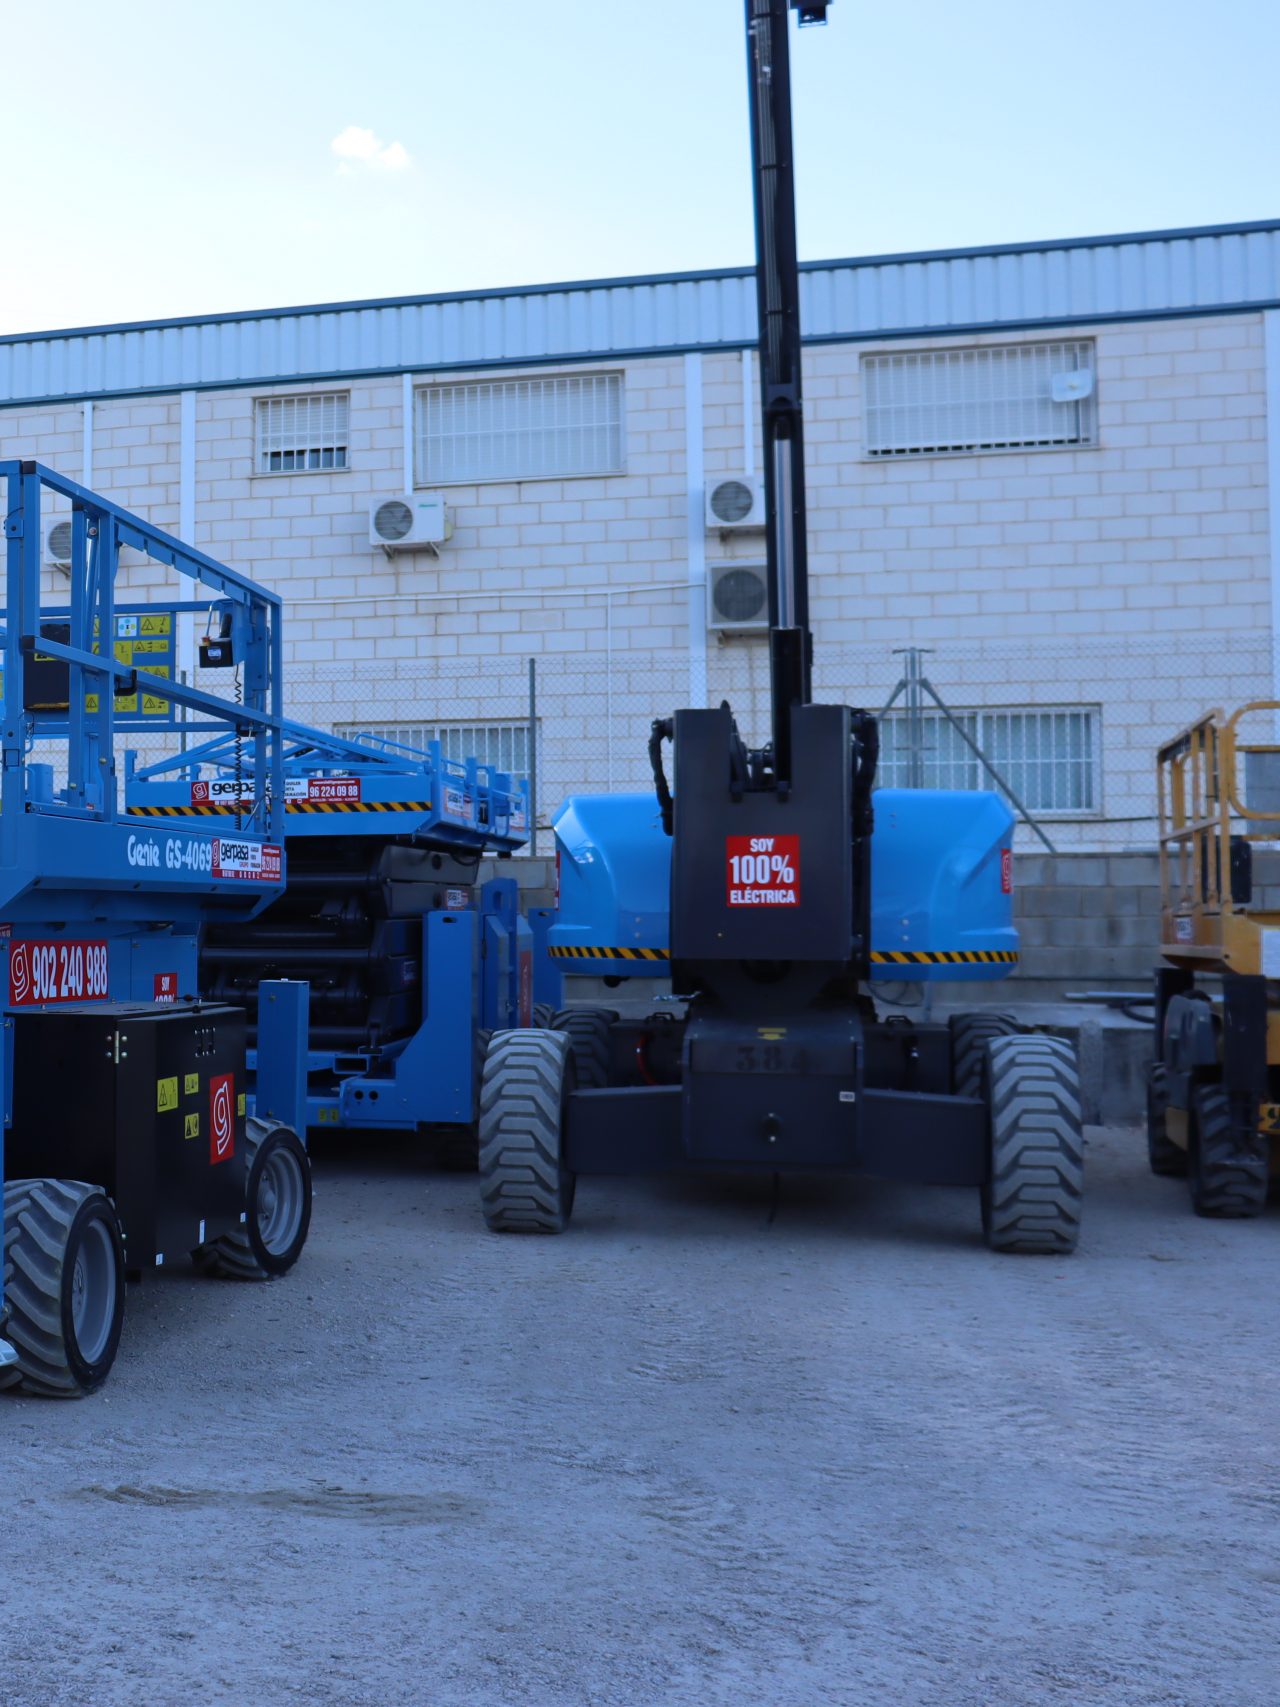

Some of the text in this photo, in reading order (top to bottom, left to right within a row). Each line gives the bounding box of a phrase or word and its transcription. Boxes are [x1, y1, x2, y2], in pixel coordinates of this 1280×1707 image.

[310, 785, 358, 798] 96 224 09 88
[127, 834, 160, 867] Genie
[165, 838, 212, 872] GS-4069
[220, 842, 249, 863] gerpasa
[750, 838, 775, 852] SOY
[729, 854, 795, 884] 100%
[730, 886, 796, 904] ELÉCTRICA
[32, 946, 57, 999] 902
[60, 946, 84, 999] 240
[86, 945, 108, 996] 988
[162, 976, 170, 992] SOY
